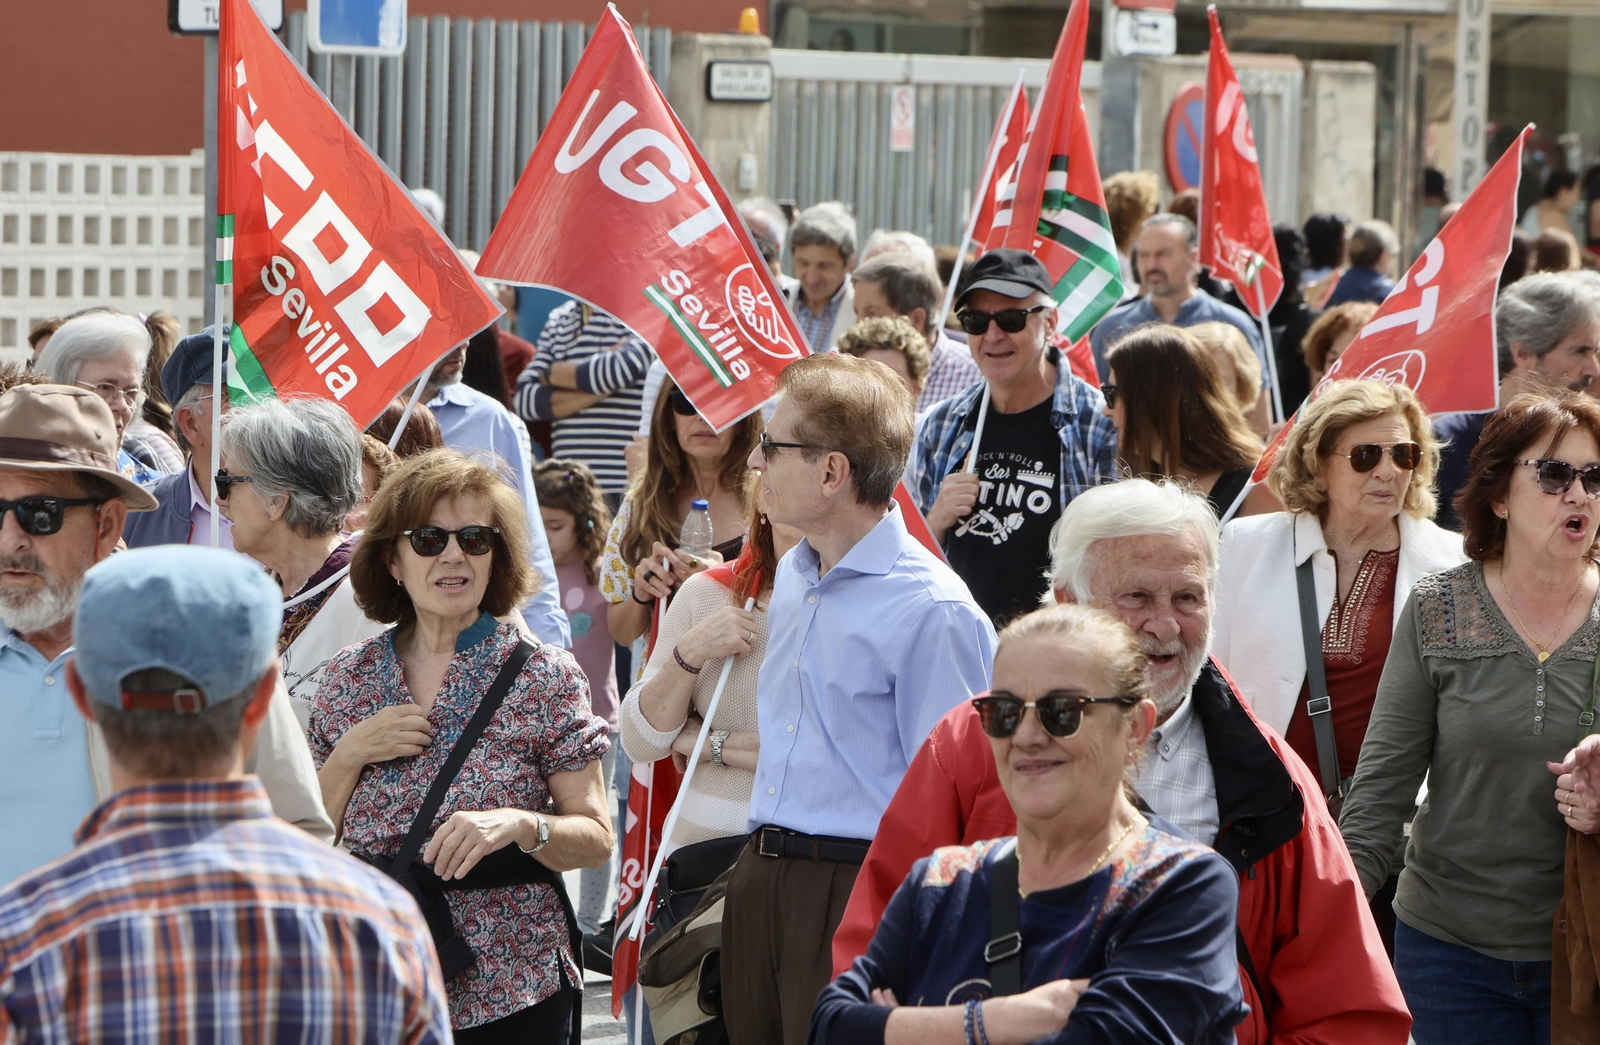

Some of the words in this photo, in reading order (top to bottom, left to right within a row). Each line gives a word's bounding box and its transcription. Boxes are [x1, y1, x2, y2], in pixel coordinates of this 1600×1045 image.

[554, 88, 727, 248] UGT
[260, 255, 359, 401] Sevilla
[660, 269, 751, 381] Sevilla
[979, 480, 1052, 515] TINO
